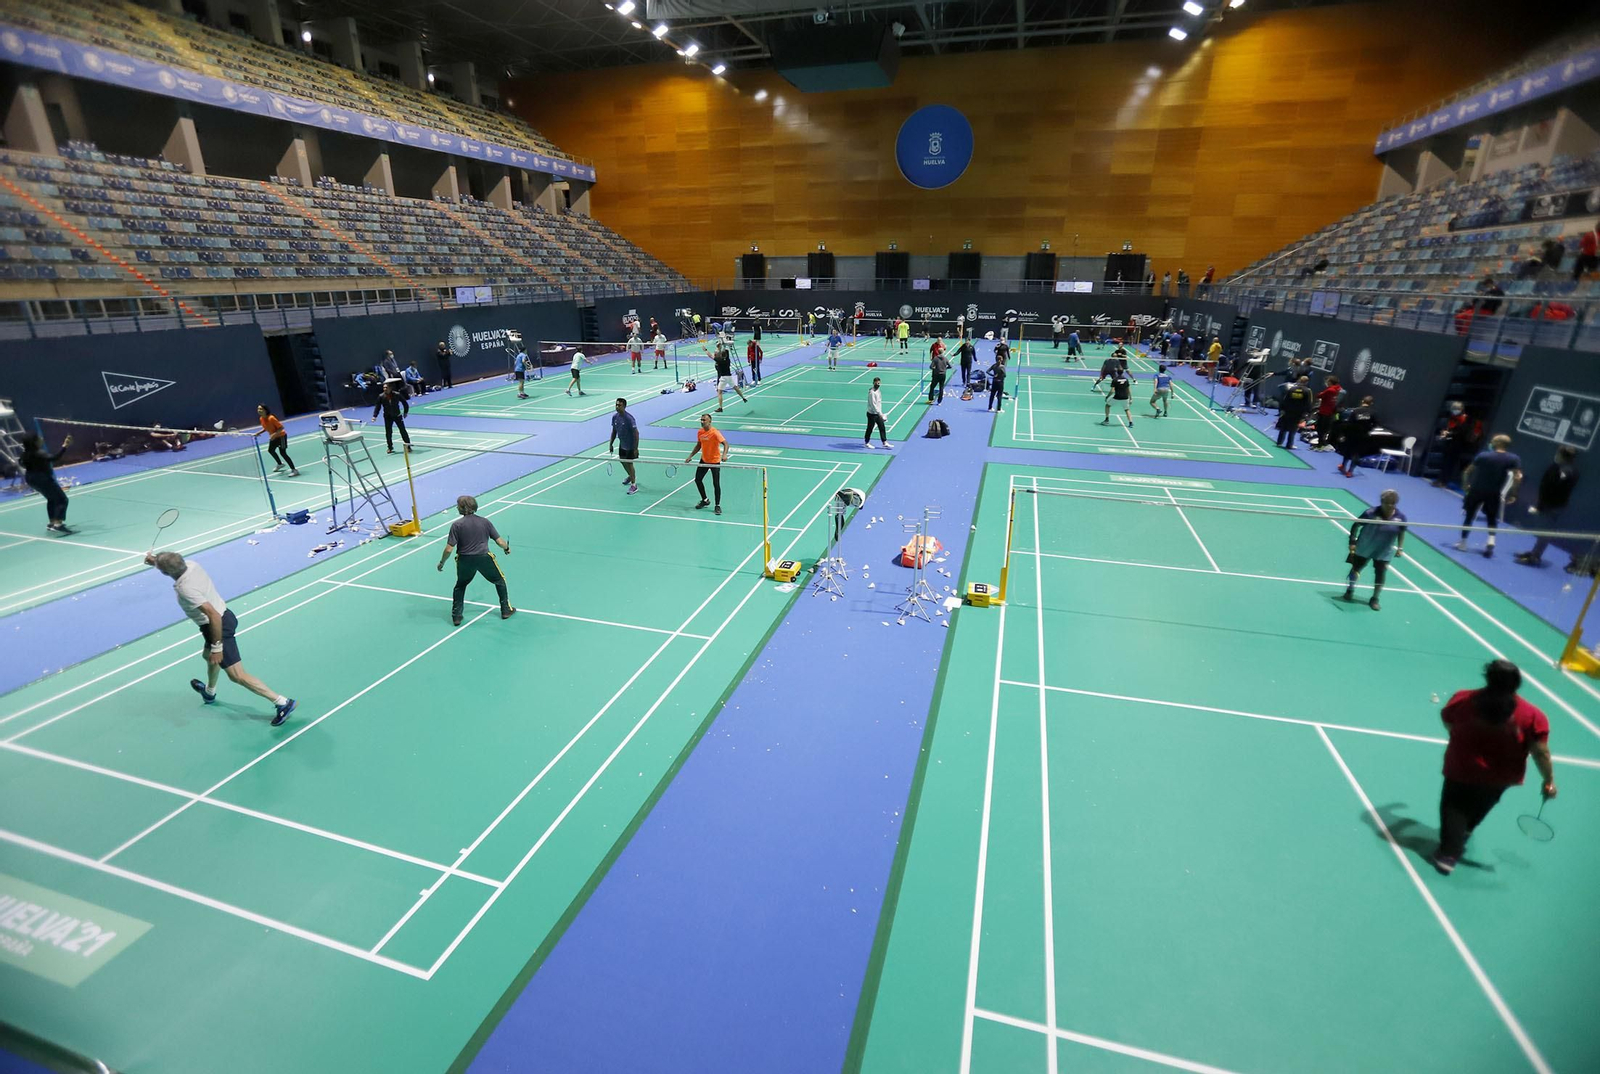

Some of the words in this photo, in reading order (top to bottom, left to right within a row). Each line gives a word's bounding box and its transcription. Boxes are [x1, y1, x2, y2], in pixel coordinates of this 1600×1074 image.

[481, 340, 505, 350] ESPAÑA
[1371, 362, 1407, 381] HUELVA'21
[1372, 377, 1394, 389] ESPAÑA
